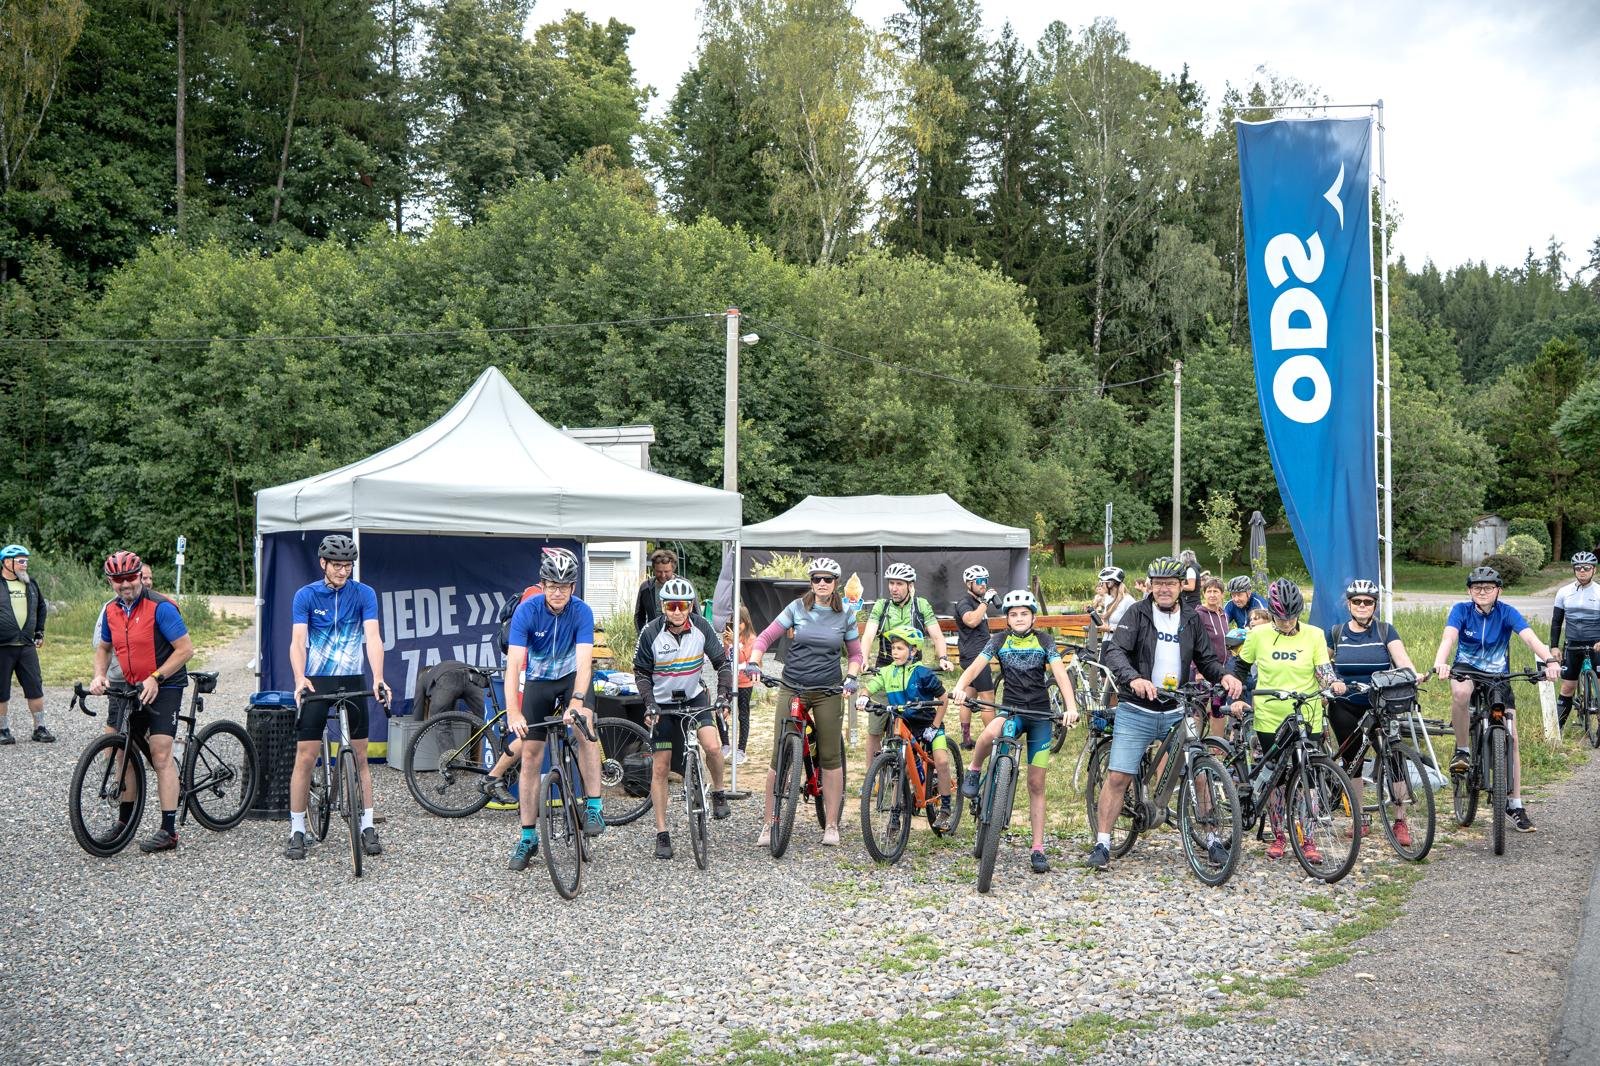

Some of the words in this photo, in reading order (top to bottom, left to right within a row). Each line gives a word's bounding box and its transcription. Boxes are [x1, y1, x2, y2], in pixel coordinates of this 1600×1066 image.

[381, 586, 460, 652] JEDE
[1157, 631, 1181, 643] ODS
[1271, 651, 1297, 661] ODS
